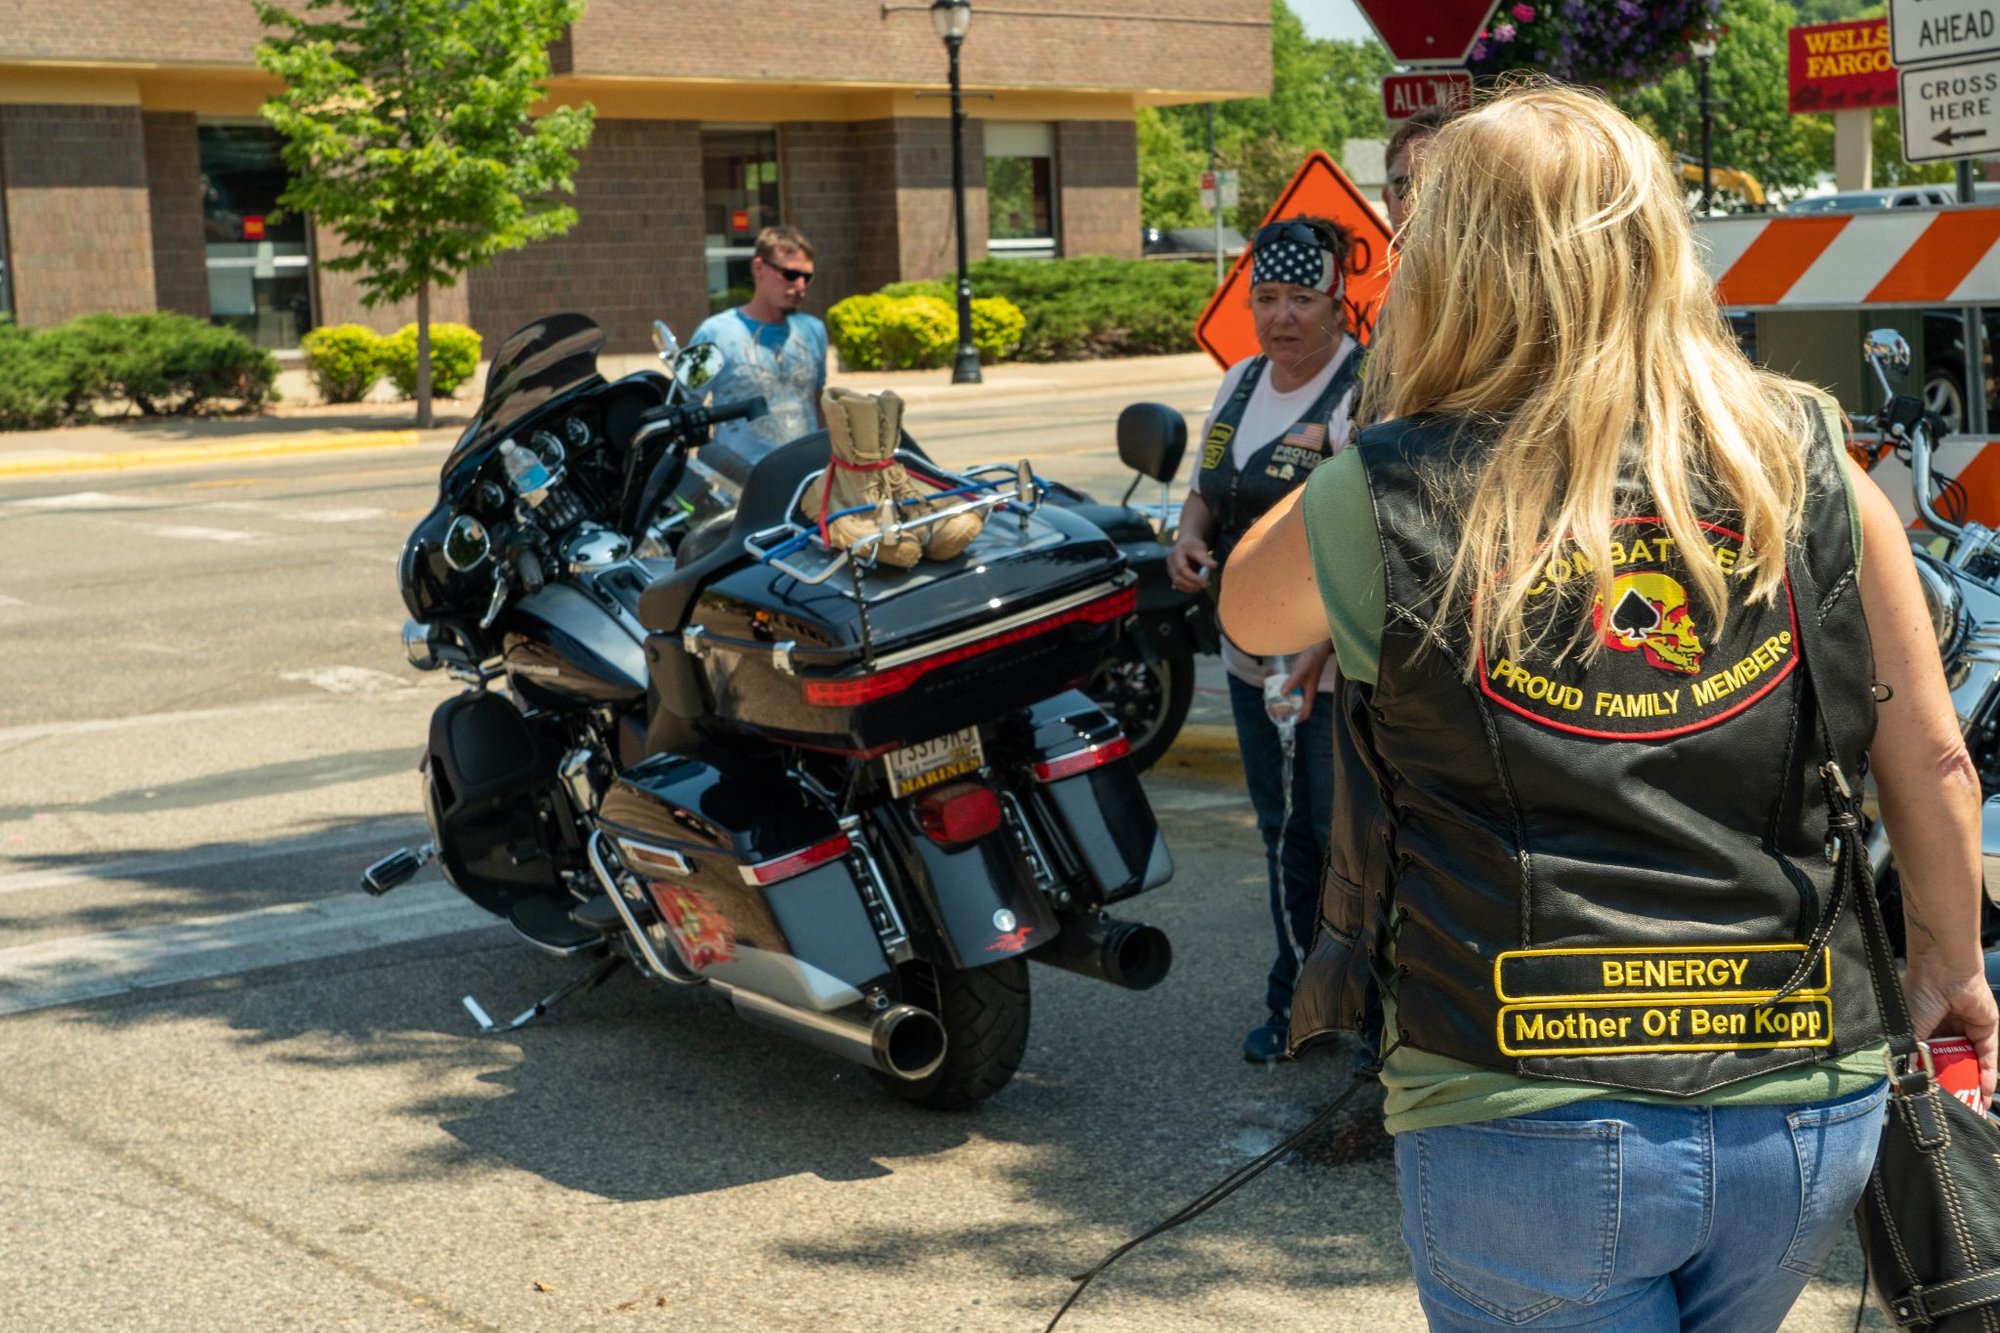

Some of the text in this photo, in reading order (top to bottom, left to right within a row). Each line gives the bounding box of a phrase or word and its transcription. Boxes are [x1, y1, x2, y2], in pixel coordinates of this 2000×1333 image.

[1804, 26, 1889, 54] WELLS
[1919, 10, 1994, 48] AHEAD
[1806, 49, 1892, 78] FARGO
[1393, 82, 1426, 112] ALL
[1920, 74, 1997, 100] CROSS
[1931, 98, 1991, 122] HERE
[1491, 658, 1583, 711] PROUD
[1594, 689, 1680, 718] FAMILY
[1602, 958, 1749, 987] BENERGY
[1515, 1007, 1822, 1041] Mother Of Ben Kopp
